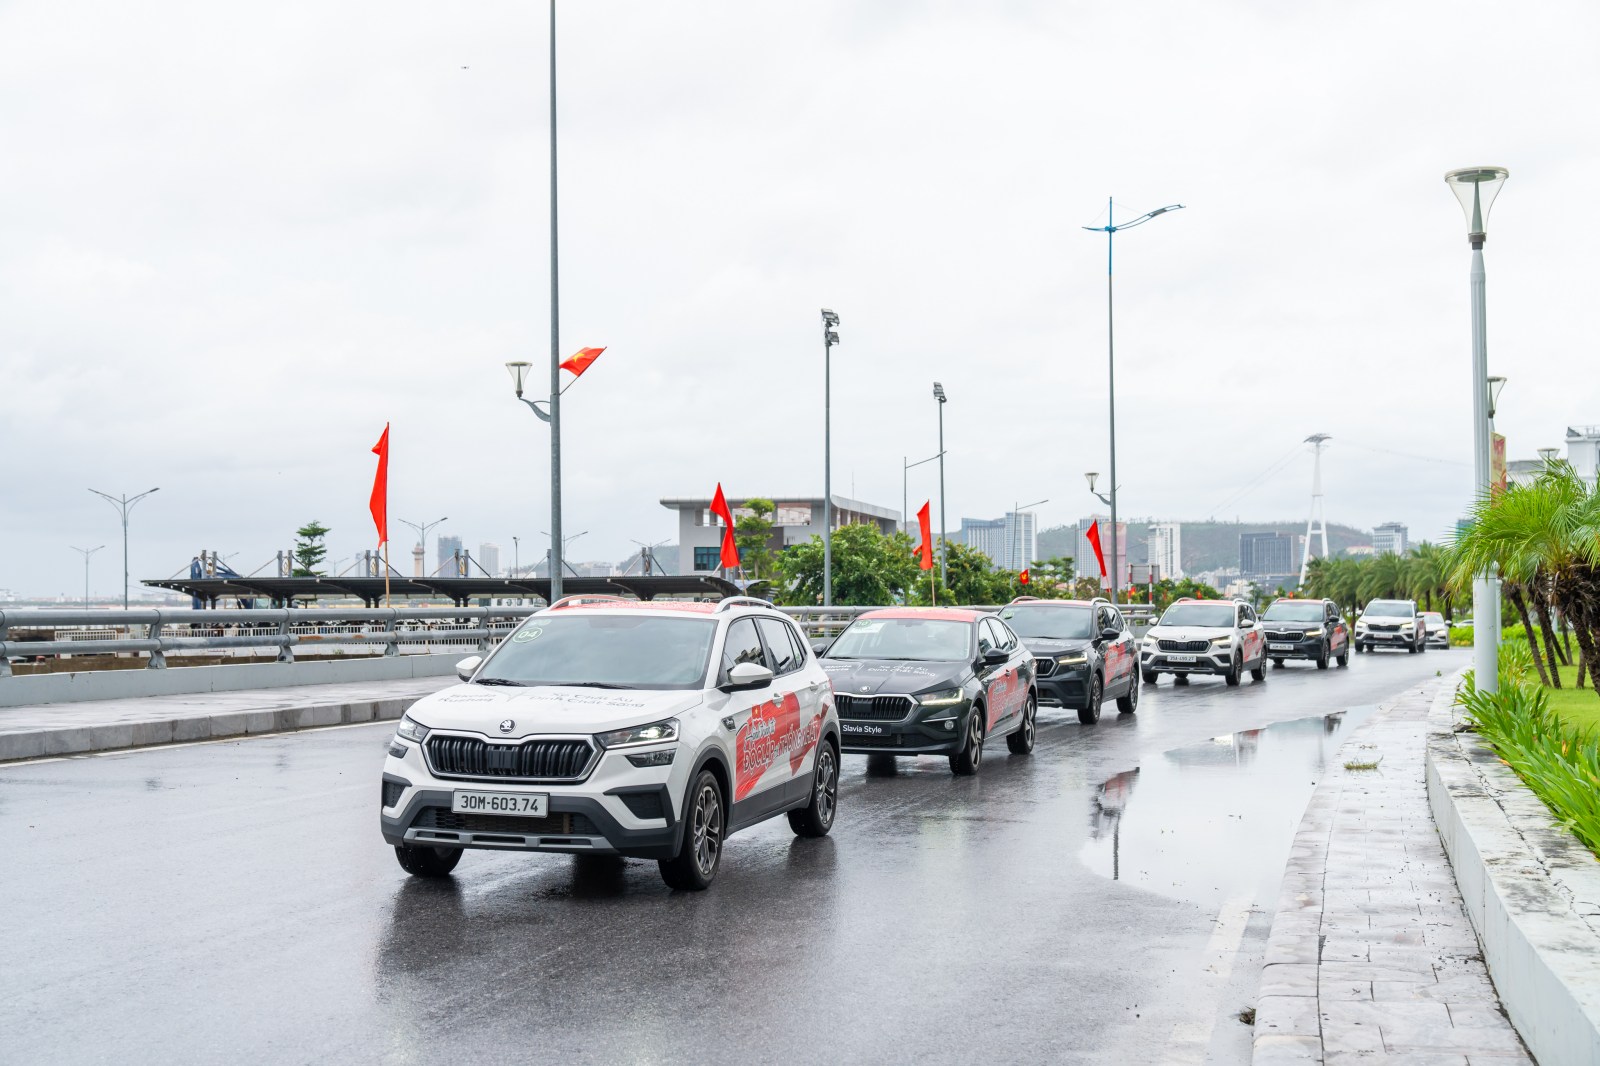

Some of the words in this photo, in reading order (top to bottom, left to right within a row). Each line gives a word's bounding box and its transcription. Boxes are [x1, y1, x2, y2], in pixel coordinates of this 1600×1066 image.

[518, 630, 539, 639] 04
[842, 724, 863, 733] Slavia
[863, 725, 882, 735] Style
[460, 795, 539, 813] 30M-603.74
